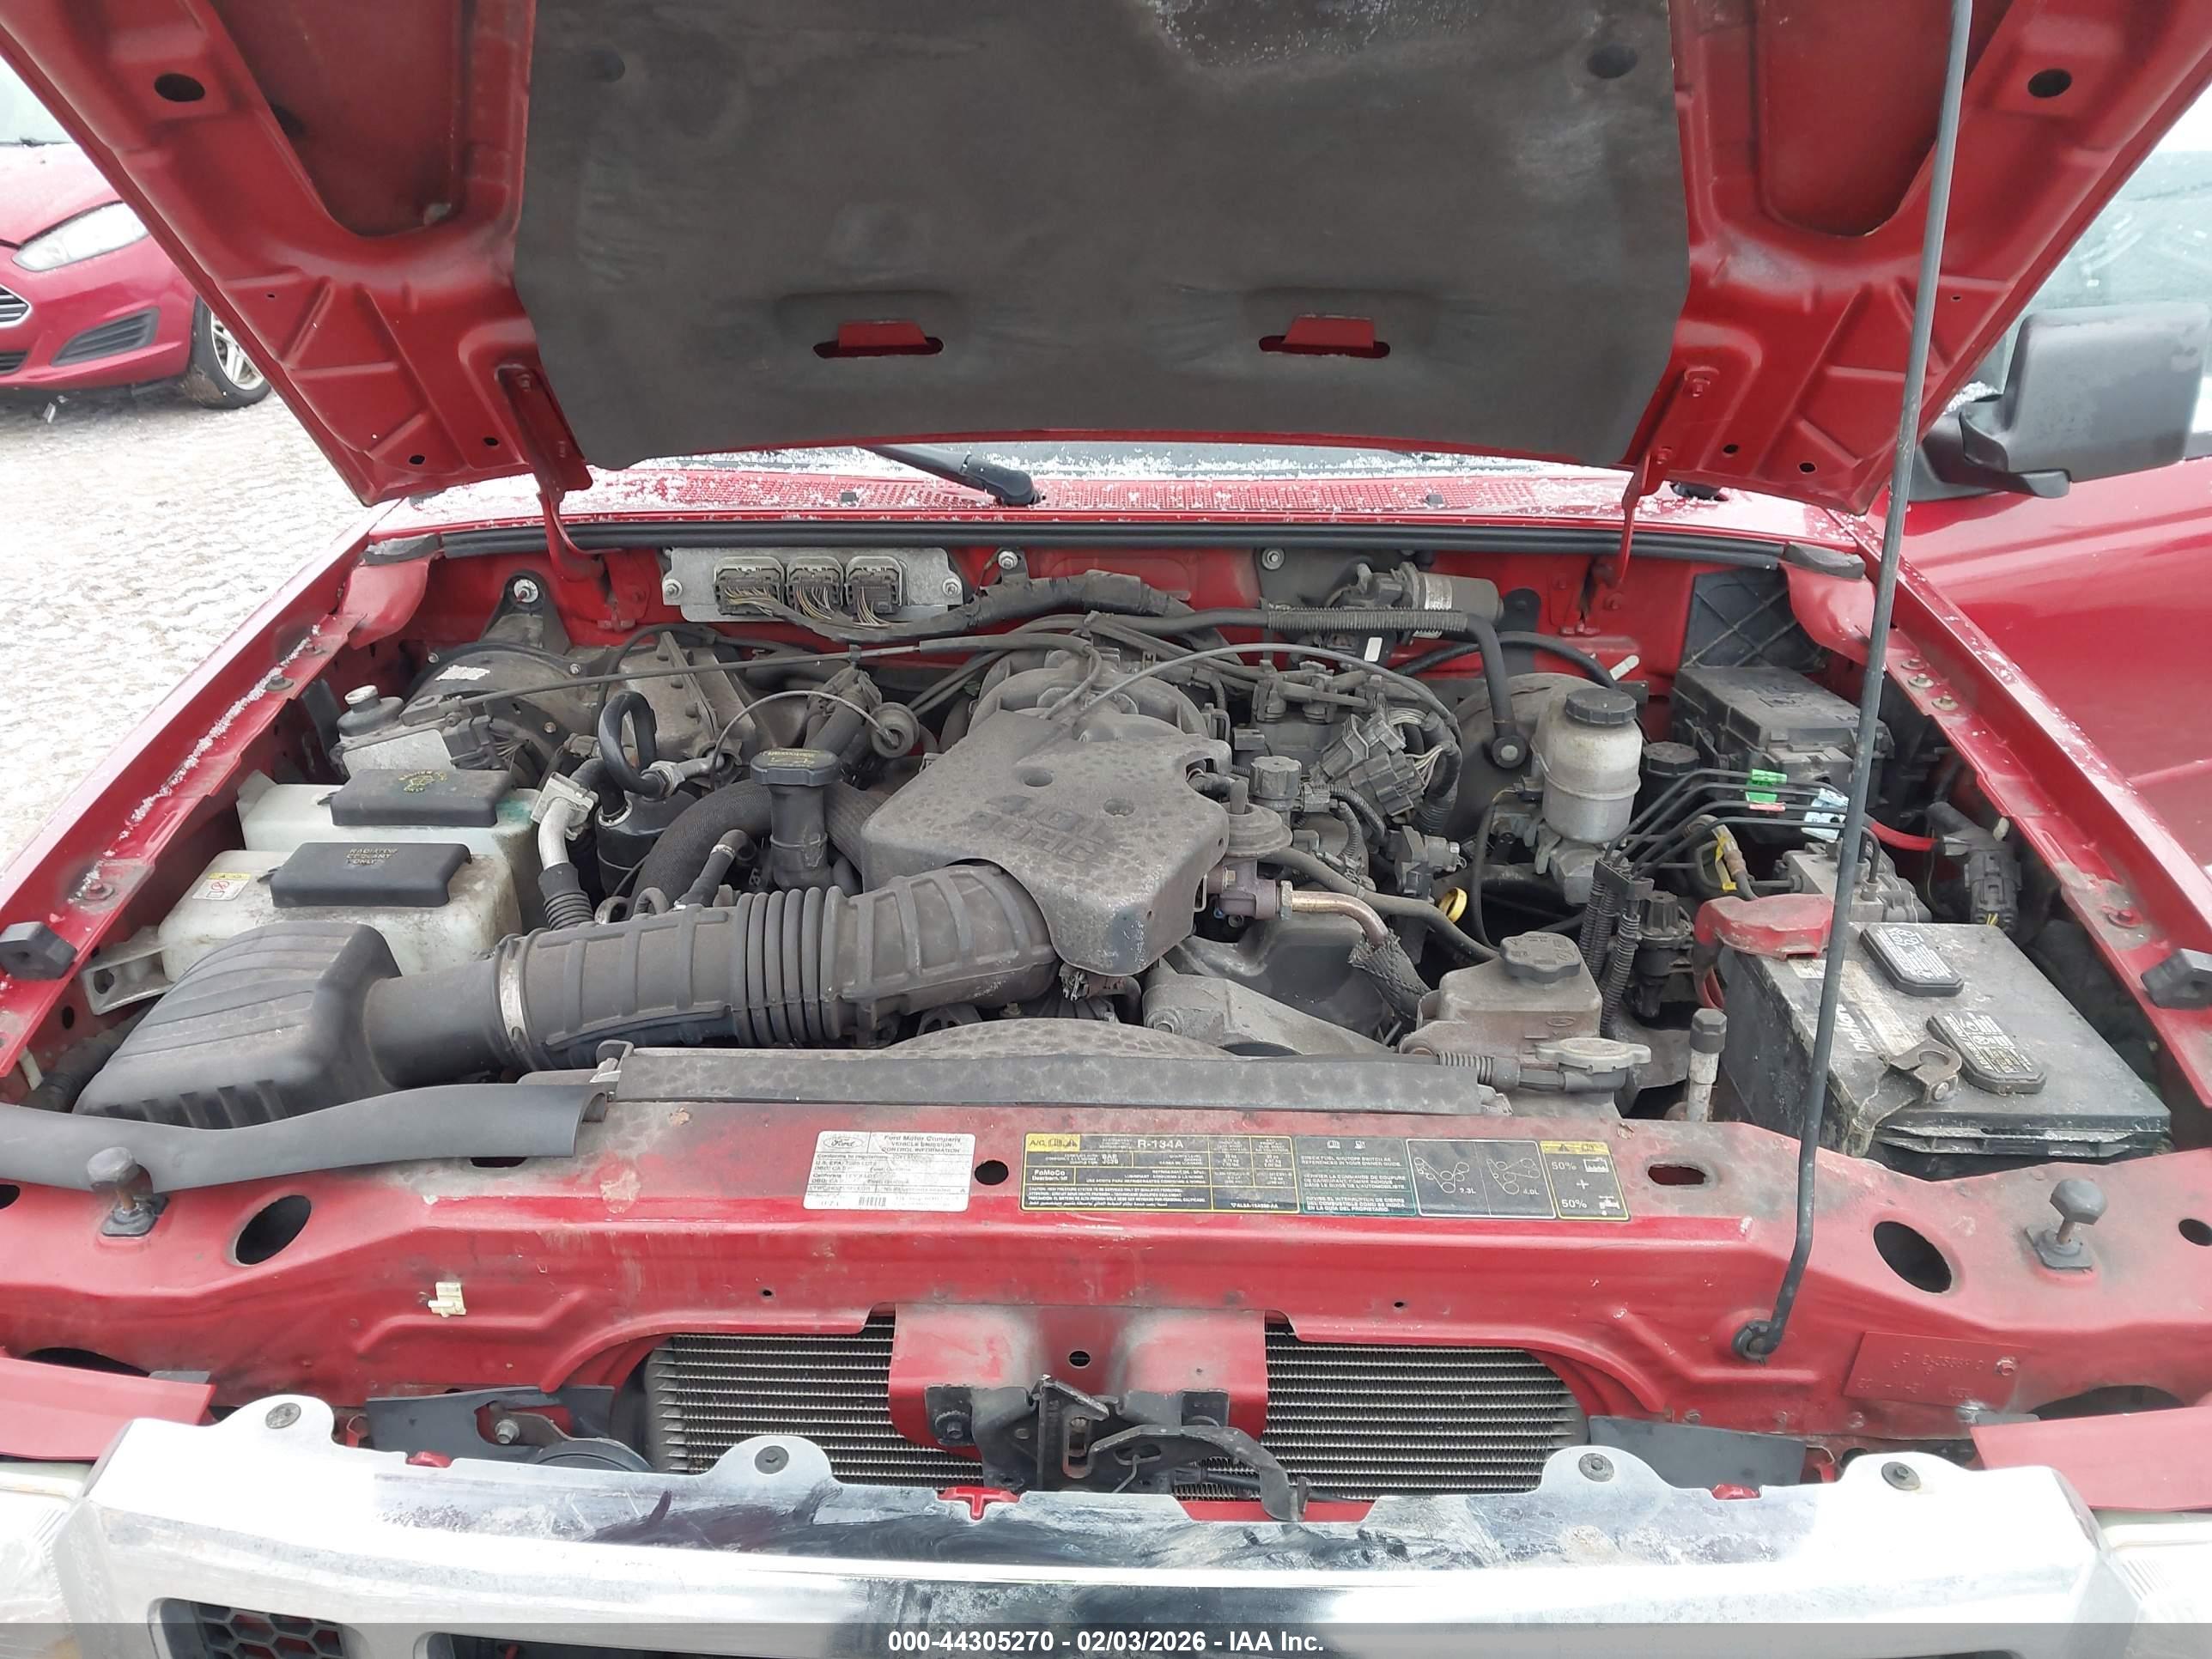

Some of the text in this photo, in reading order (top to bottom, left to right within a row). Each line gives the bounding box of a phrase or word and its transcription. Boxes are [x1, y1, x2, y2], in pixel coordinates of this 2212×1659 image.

[830, 1139, 855, 1147] Ford
[1137, 1139, 1184, 1149] R-134A
[1551, 1161, 1577, 1170] 50%
[1561, 1199, 1588, 1209] 50%
